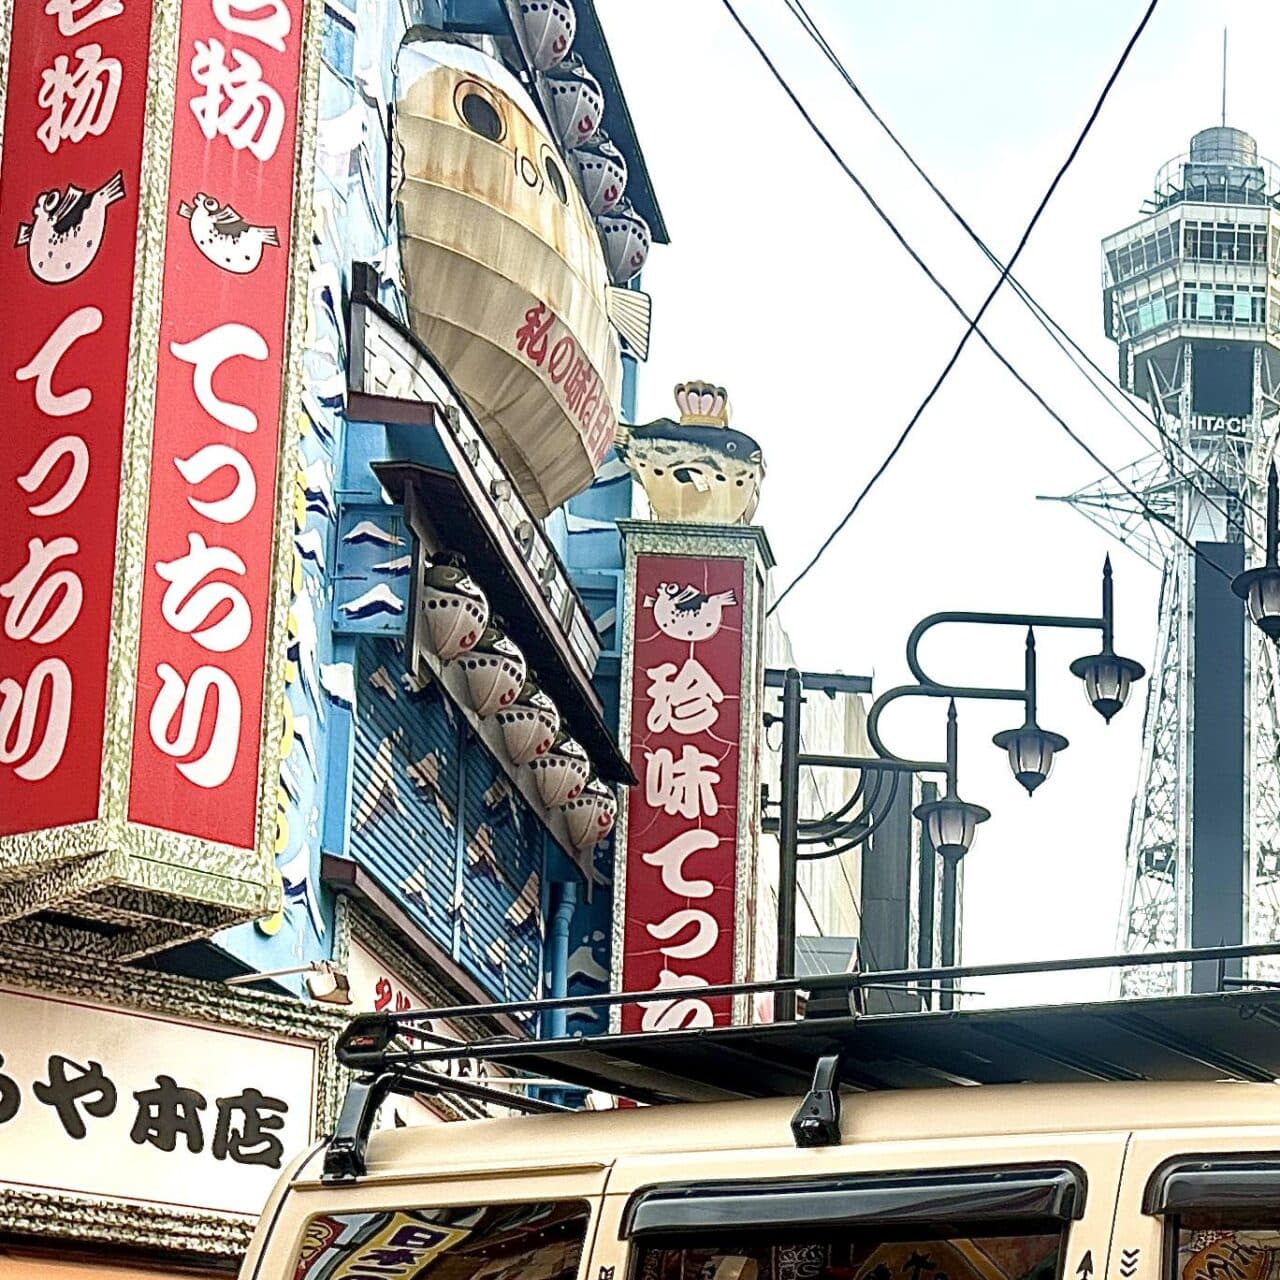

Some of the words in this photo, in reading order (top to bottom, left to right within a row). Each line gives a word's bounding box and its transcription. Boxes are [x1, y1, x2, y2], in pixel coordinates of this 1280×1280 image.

[0, 306, 102, 781] てっちり
[149, 322, 270, 787] てっちり
[1188, 415, 1257, 433] HITACH
